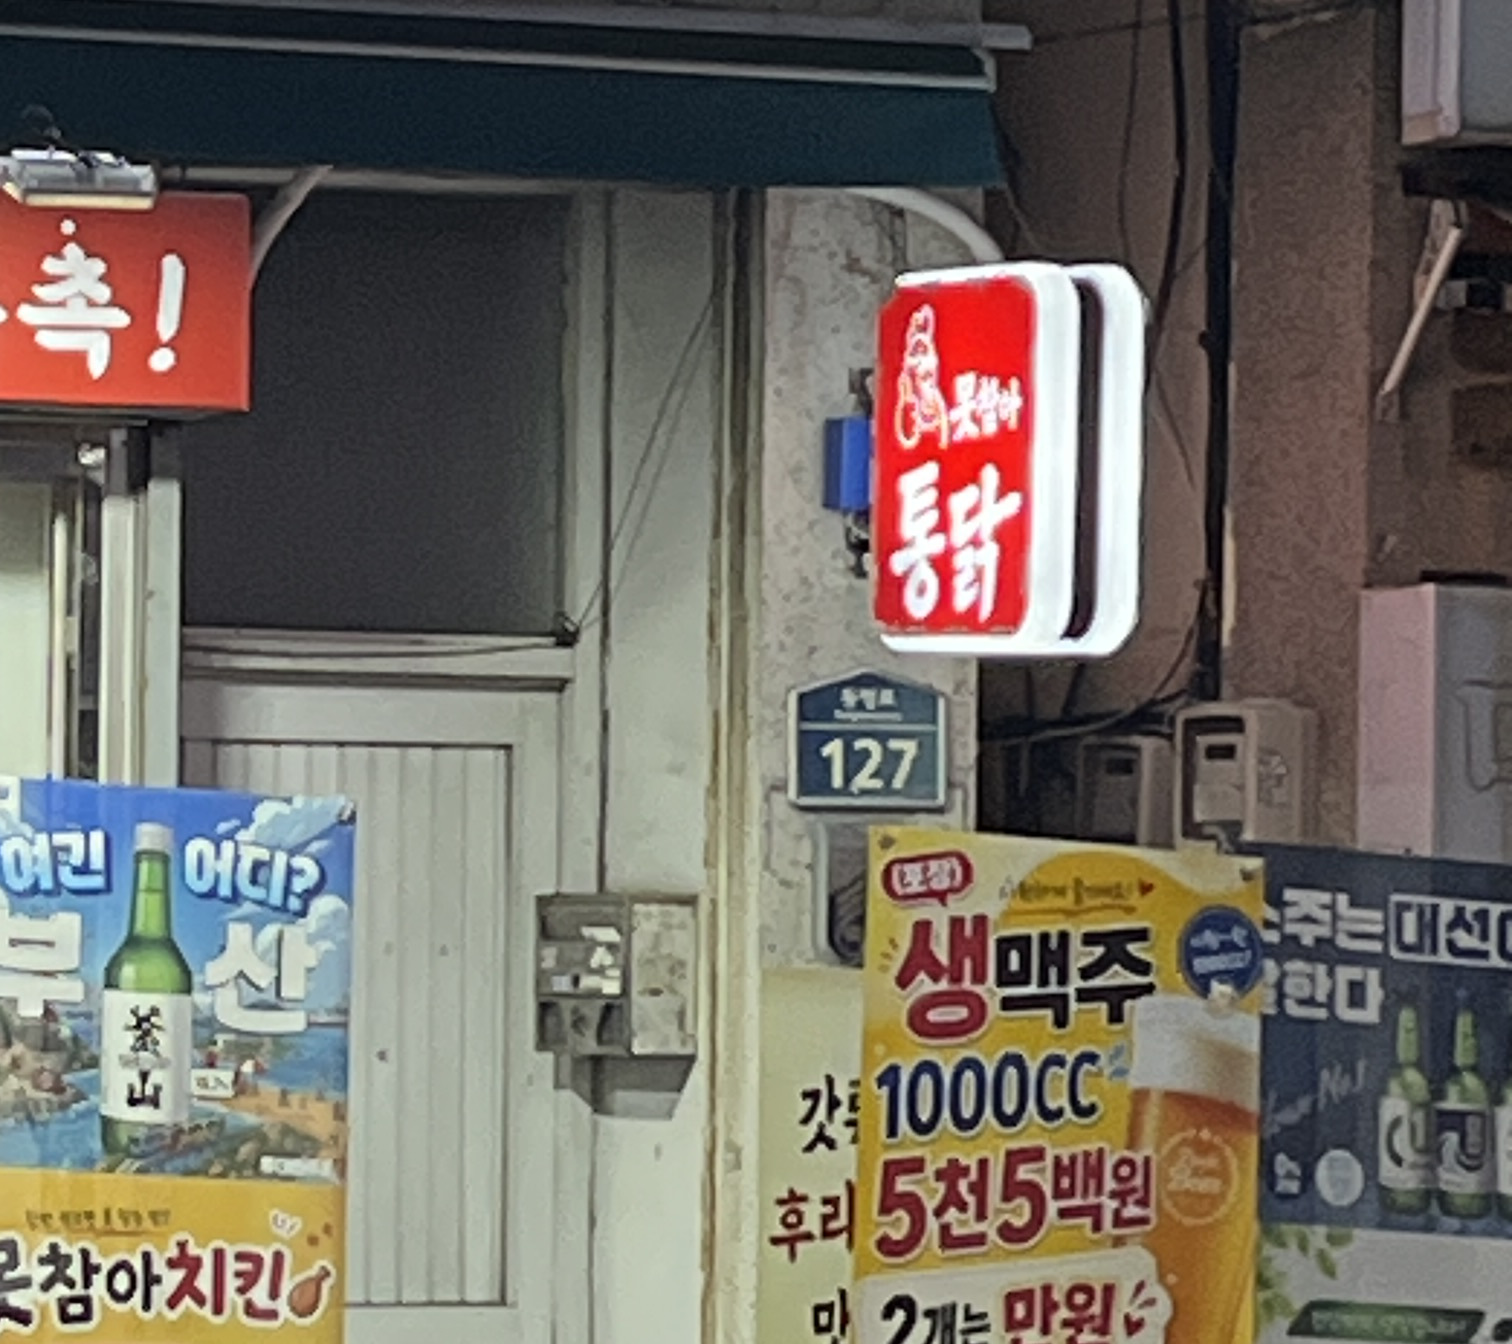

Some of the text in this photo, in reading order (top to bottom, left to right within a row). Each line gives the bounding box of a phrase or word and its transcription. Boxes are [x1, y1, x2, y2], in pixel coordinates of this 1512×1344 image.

[890, 460, 1022, 623] 통닭
[819, 737, 920, 795] 127
[0, 829, 326, 915] 여긴 어디?
[1261, 885, 1385, 955] 주는
[1394, 898, 1512, 964] 대선
[205, 920, 318, 1034] 산
[893, 912, 1156, 1040] 생맥주
[873, 1143, 1155, 1259] 5천5백원
